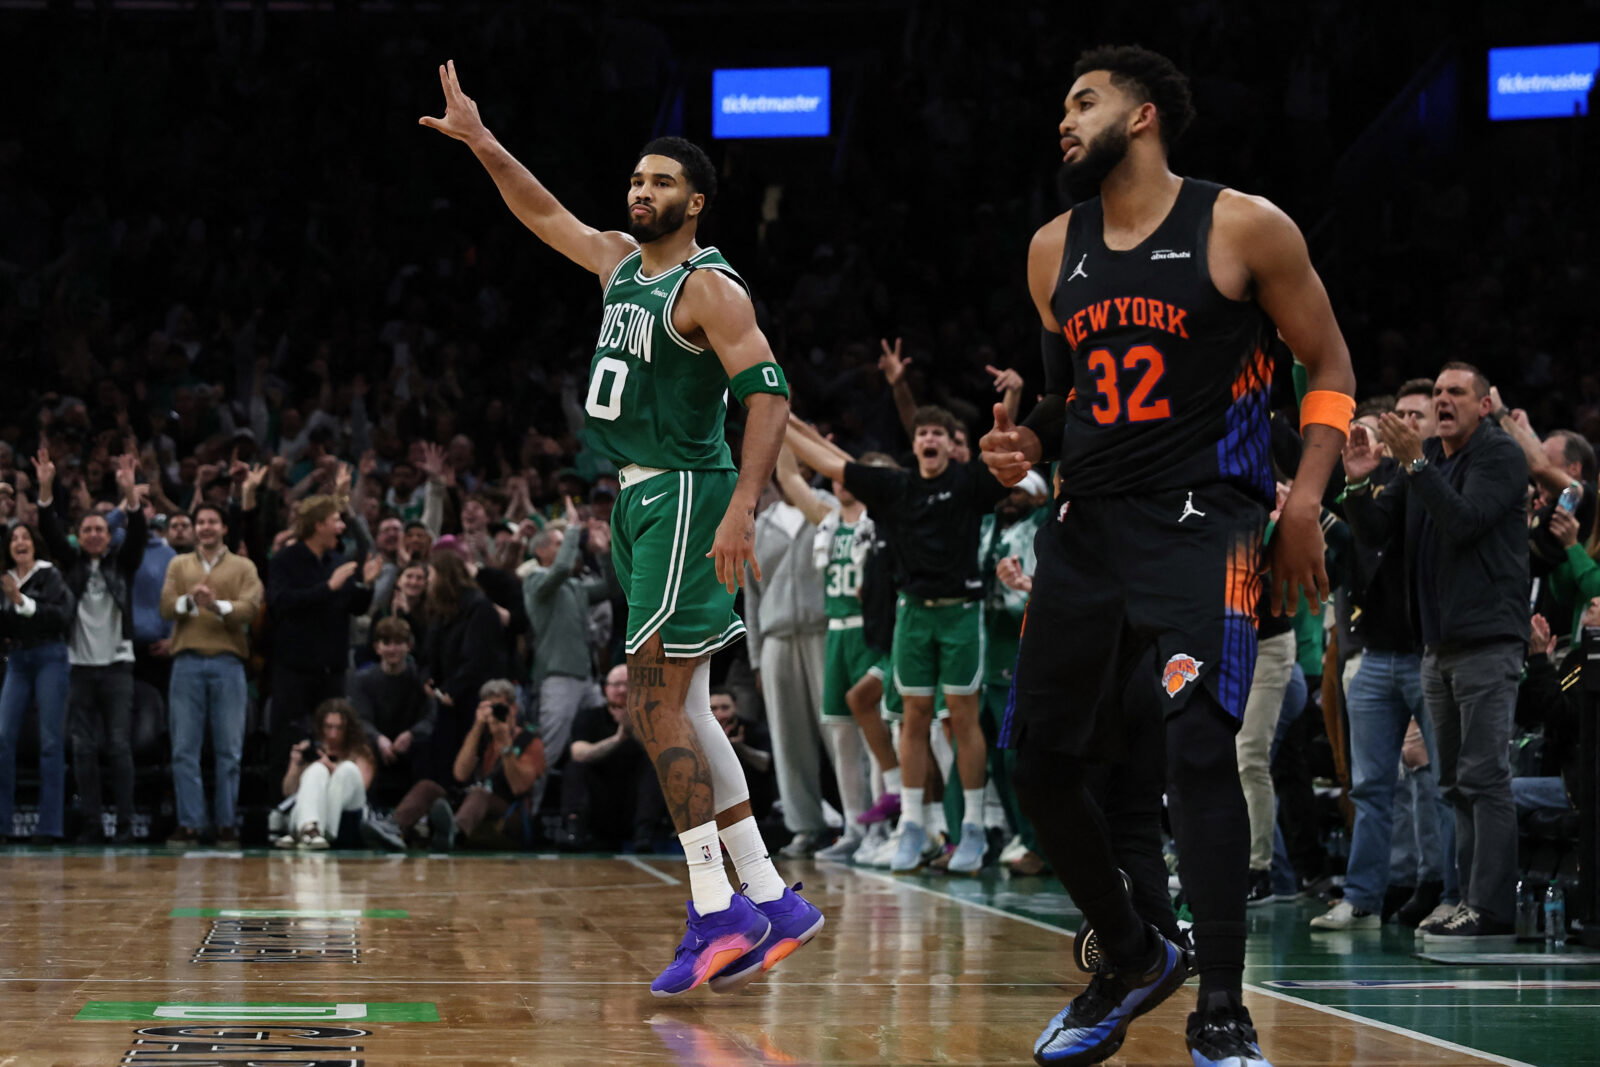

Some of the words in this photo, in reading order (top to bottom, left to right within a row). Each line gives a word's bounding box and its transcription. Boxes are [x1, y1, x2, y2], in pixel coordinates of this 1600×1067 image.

[1063, 300, 1111, 350] NEW
[1114, 297, 1189, 339] YORK
[584, 356, 630, 421] 0
[762, 366, 779, 387] 0
[1087, 343, 1172, 425] 32
[826, 563, 863, 596] 30
